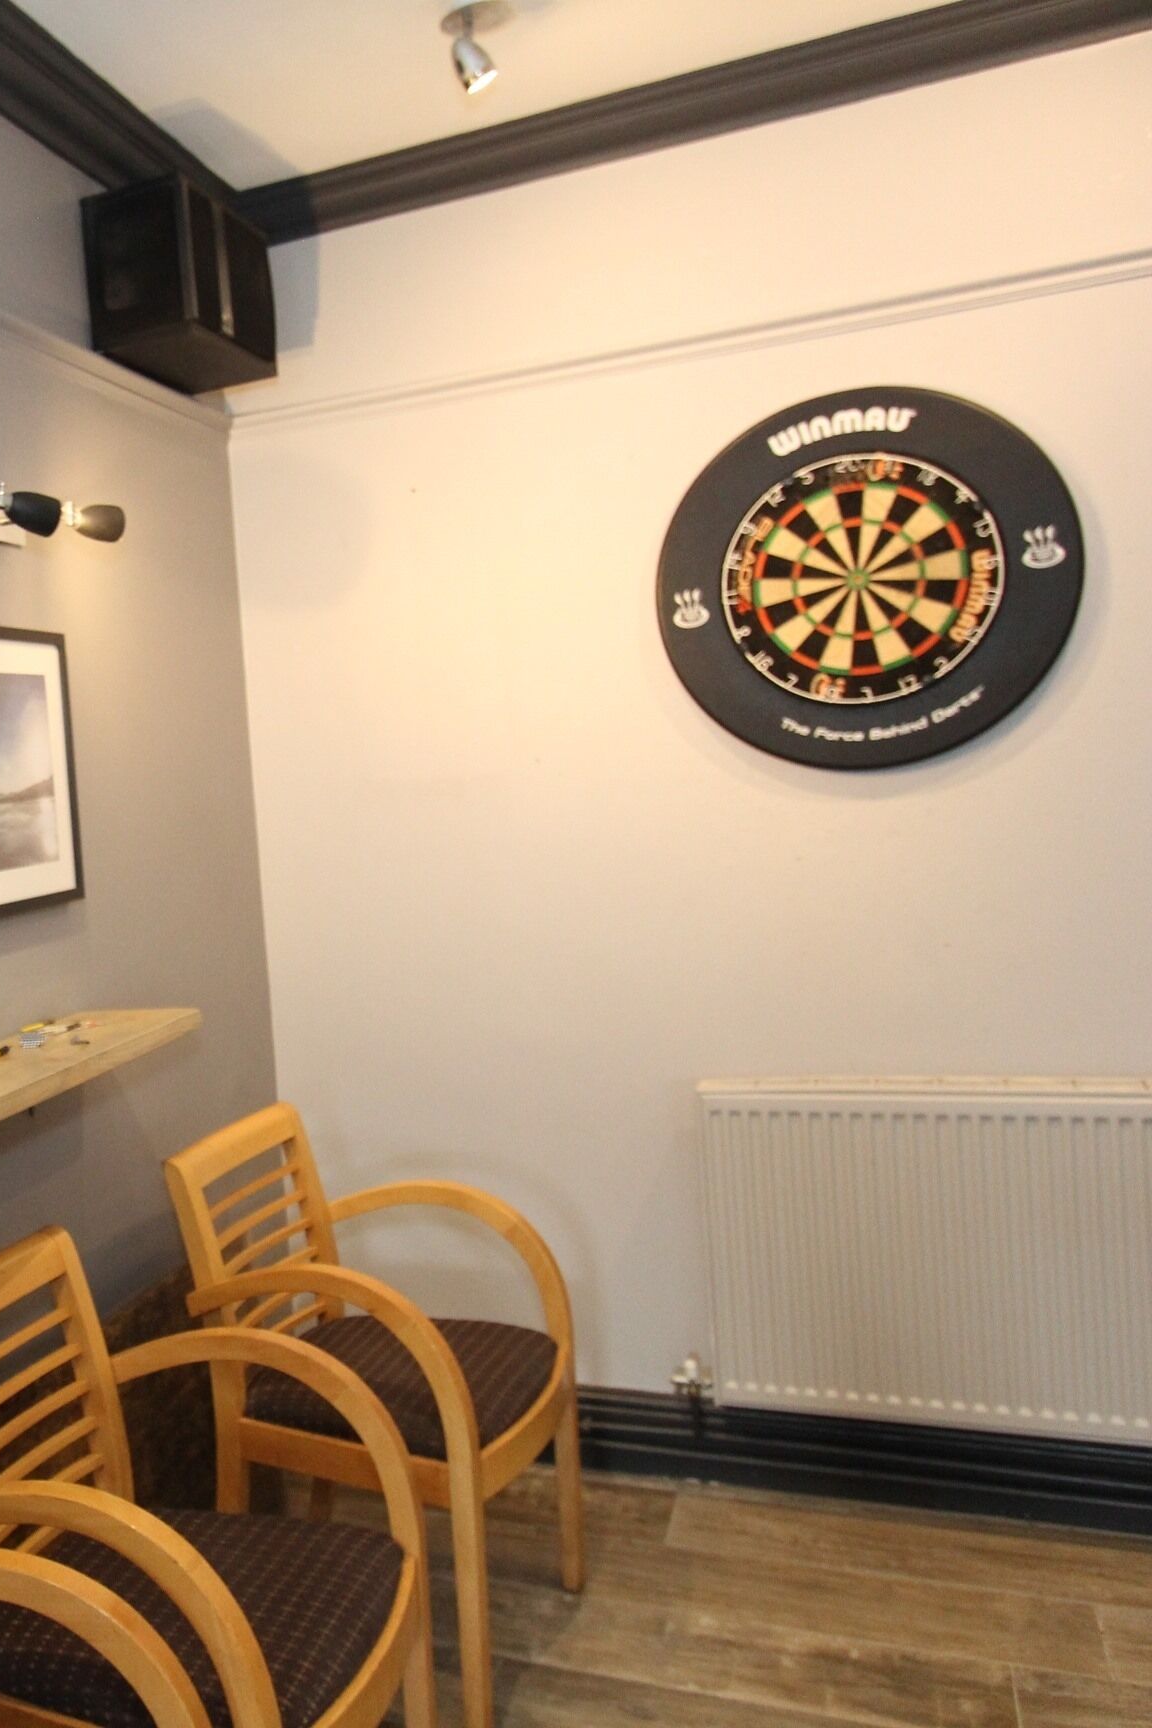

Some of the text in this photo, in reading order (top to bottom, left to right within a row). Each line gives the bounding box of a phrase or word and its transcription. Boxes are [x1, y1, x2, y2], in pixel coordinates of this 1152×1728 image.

[767, 406, 917, 457] WINMAU
[782, 716, 811, 736] The
[813, 726, 865, 742] Force
[869, 715, 928, 741] Behind
